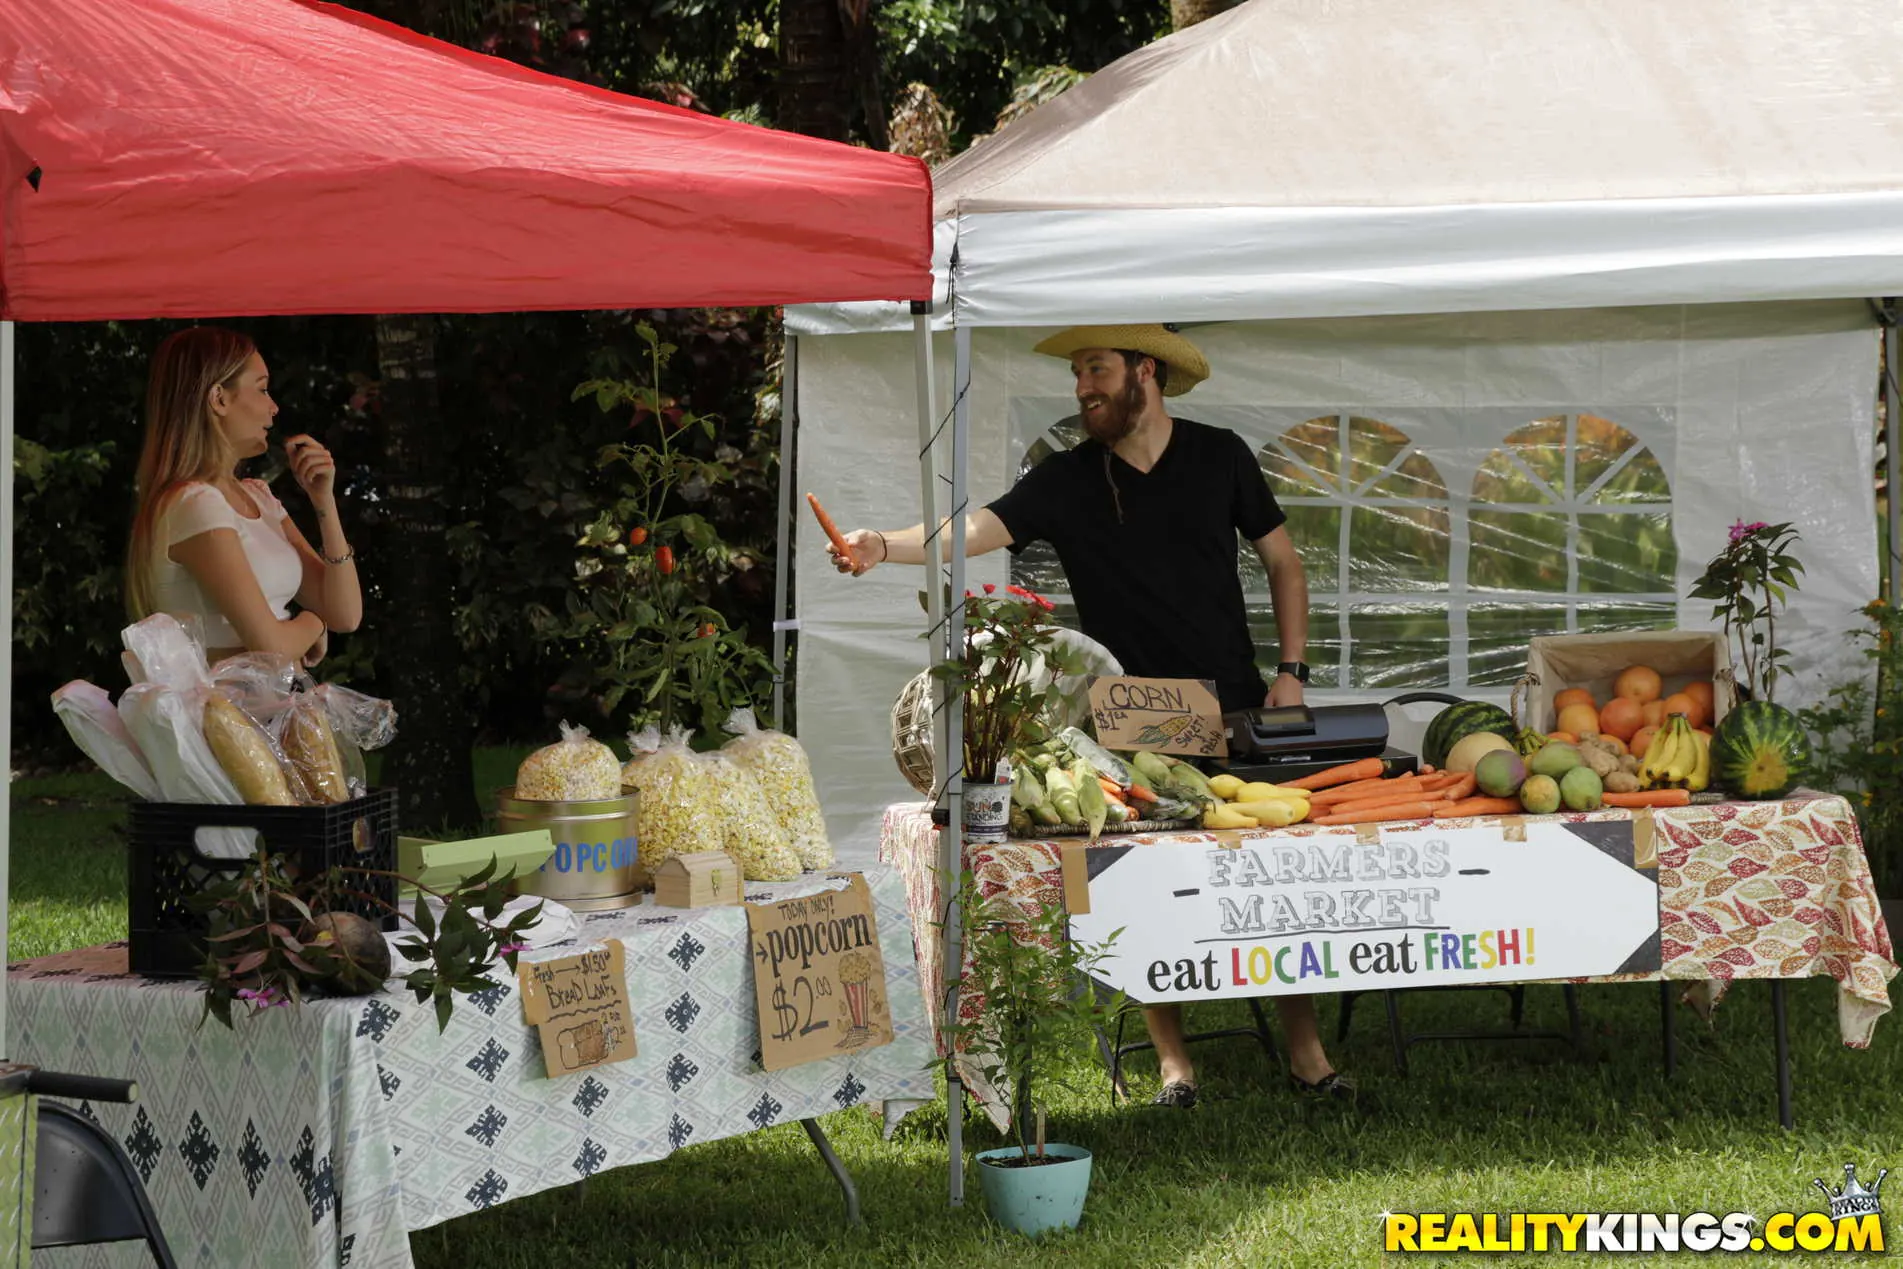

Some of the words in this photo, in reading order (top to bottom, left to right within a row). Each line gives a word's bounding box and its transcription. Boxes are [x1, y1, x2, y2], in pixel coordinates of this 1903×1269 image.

[1110, 683, 1183, 709] CORN
[1206, 840, 1451, 888] FARMERS
[1219, 887, 1440, 934] MARKET
[766, 913, 873, 978] popcorn
[1147, 950, 1221, 993] eat
[1231, 941, 1340, 986] LOCAL
[1349, 933, 1418, 975] eat
[1424, 927, 1535, 971] FRESH!
